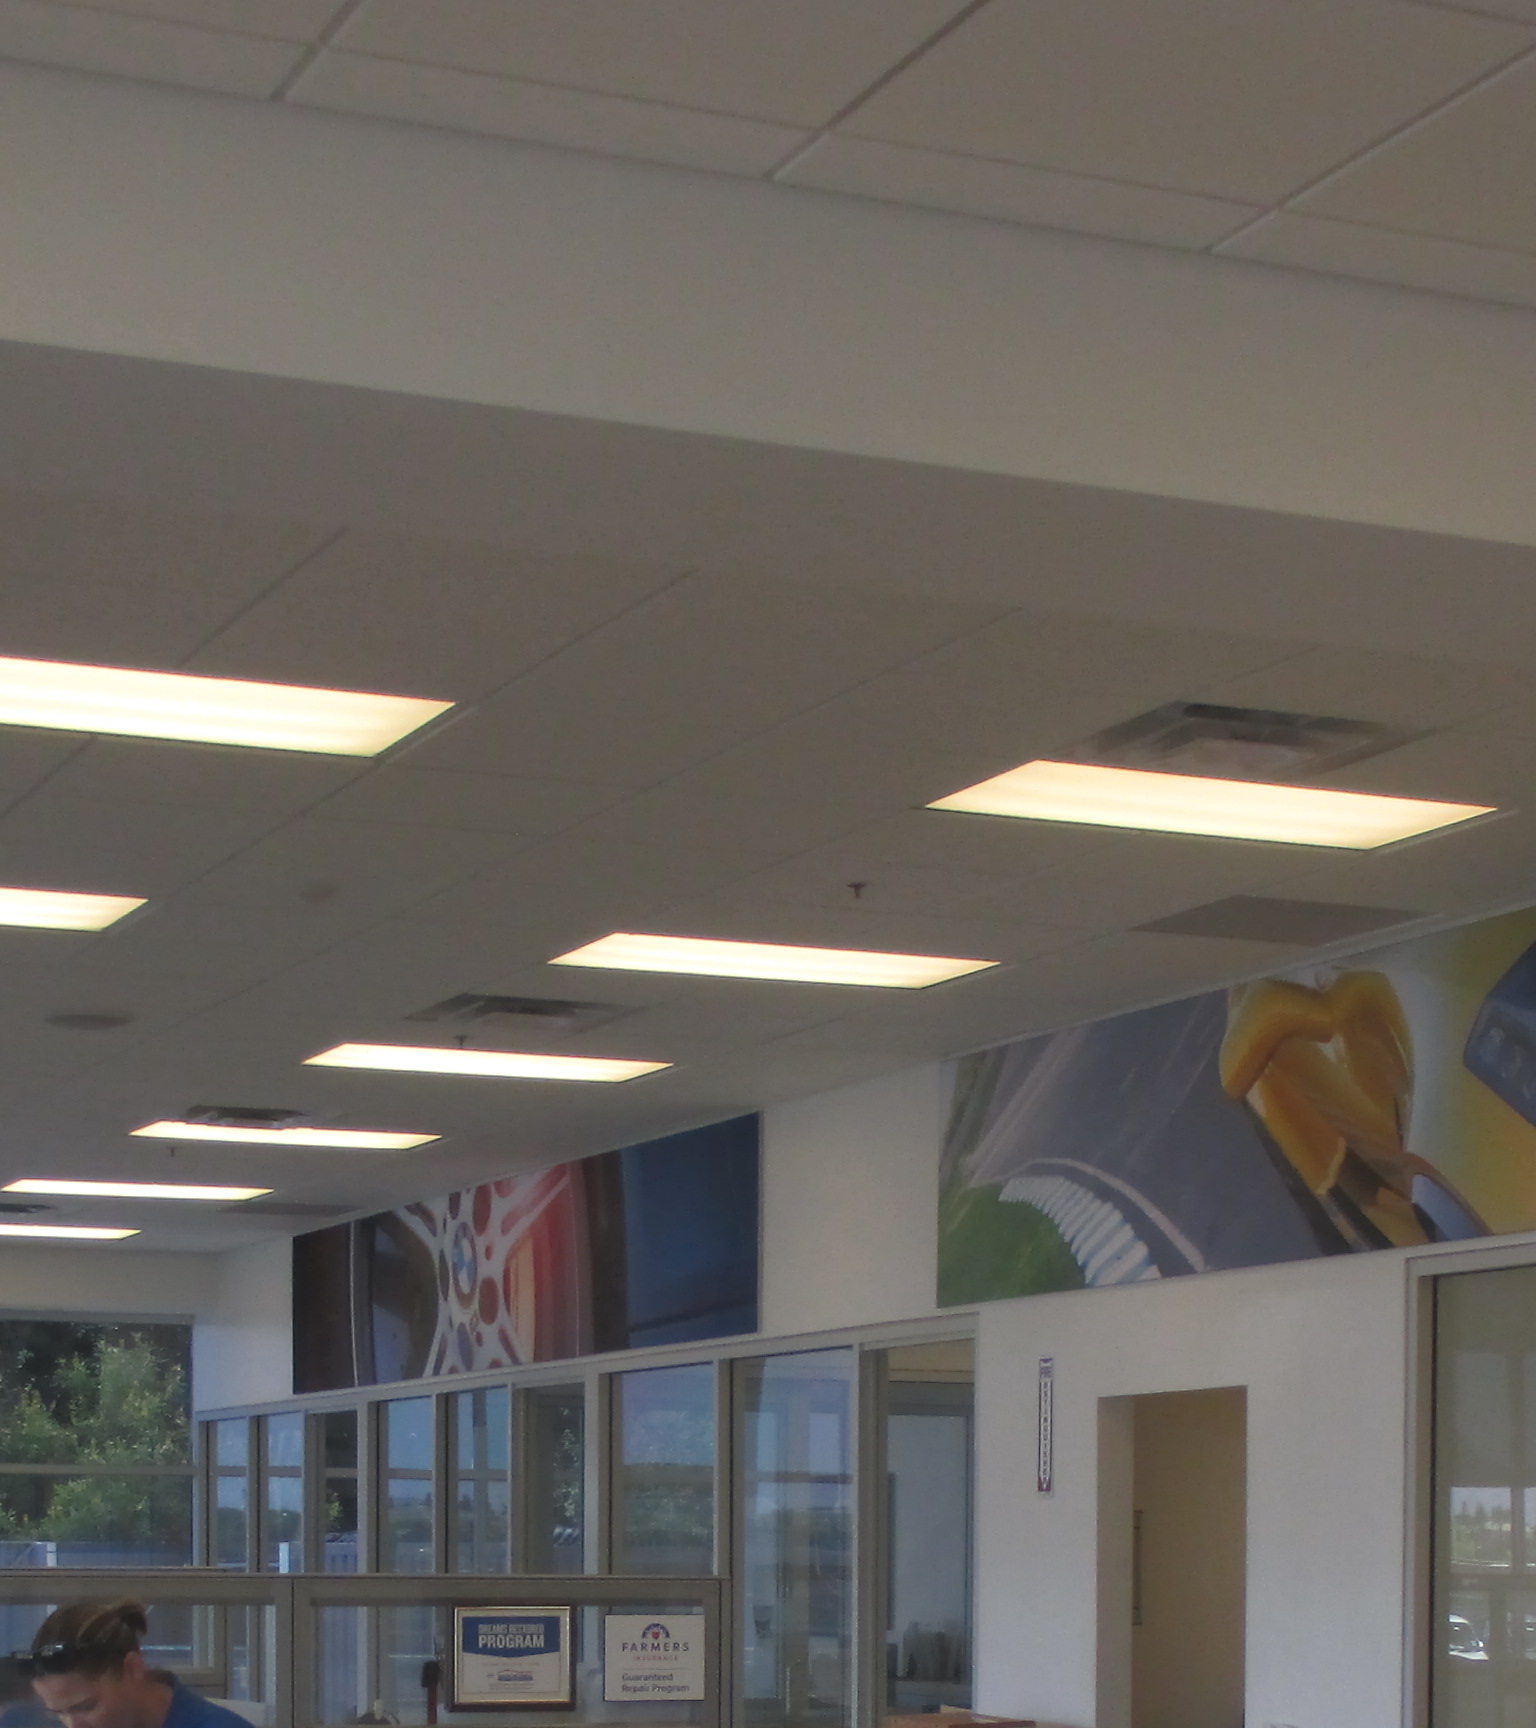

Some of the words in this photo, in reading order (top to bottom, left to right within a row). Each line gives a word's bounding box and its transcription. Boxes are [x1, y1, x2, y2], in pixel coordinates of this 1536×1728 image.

[478, 1634, 544, 1648] PROGRAM
[622, 1642, 690, 1652] FARMERS
[622, 1673, 674, 1681] Guaranteed
[622, 1683, 650, 1695] Repair
[652, 1683, 690, 1694] Program
